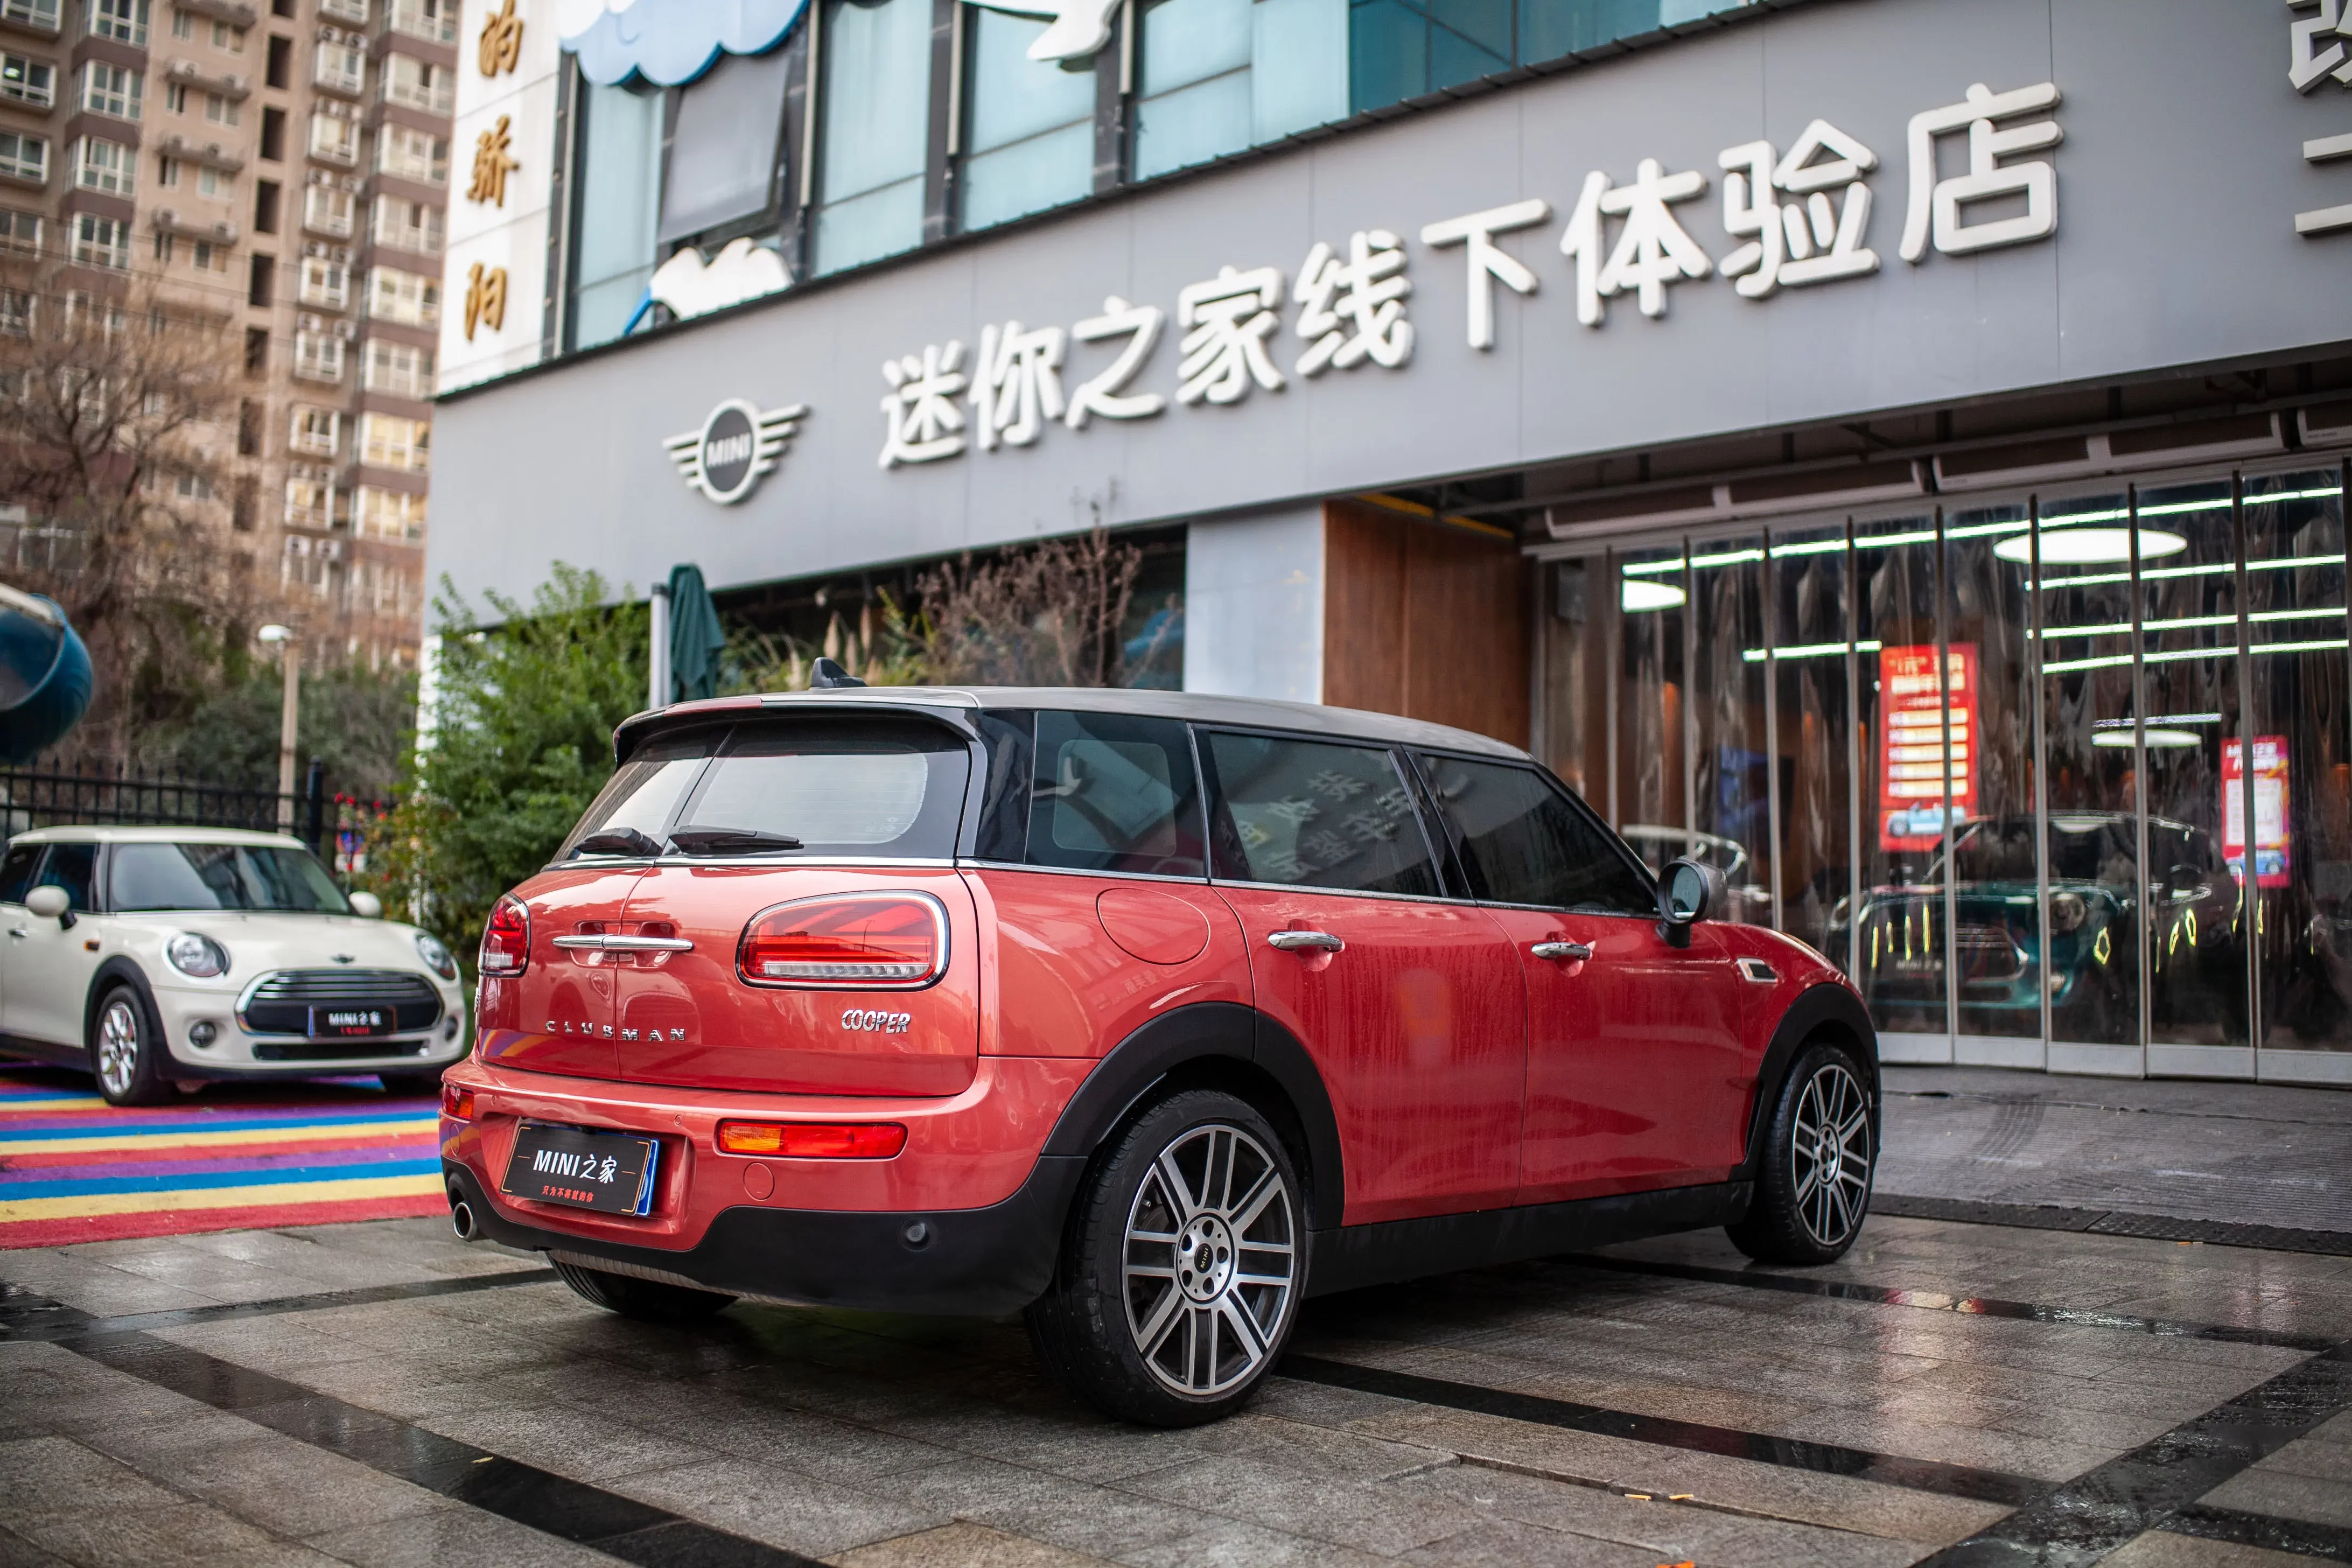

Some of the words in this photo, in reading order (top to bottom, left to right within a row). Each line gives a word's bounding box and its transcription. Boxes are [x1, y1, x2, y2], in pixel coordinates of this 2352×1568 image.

[879, 82, 2063, 468] 迷你之家线下体验店
[706, 432, 752, 468] MINI
[545, 1020, 685, 1042] CLUBMAN
[841, 1009, 911, 1033] COOPER
[533, 1149, 618, 1184] MINI之家
[542, 1185, 594, 1202] 只为不将就的你
[1200, 1247, 1209, 1269] MINI
